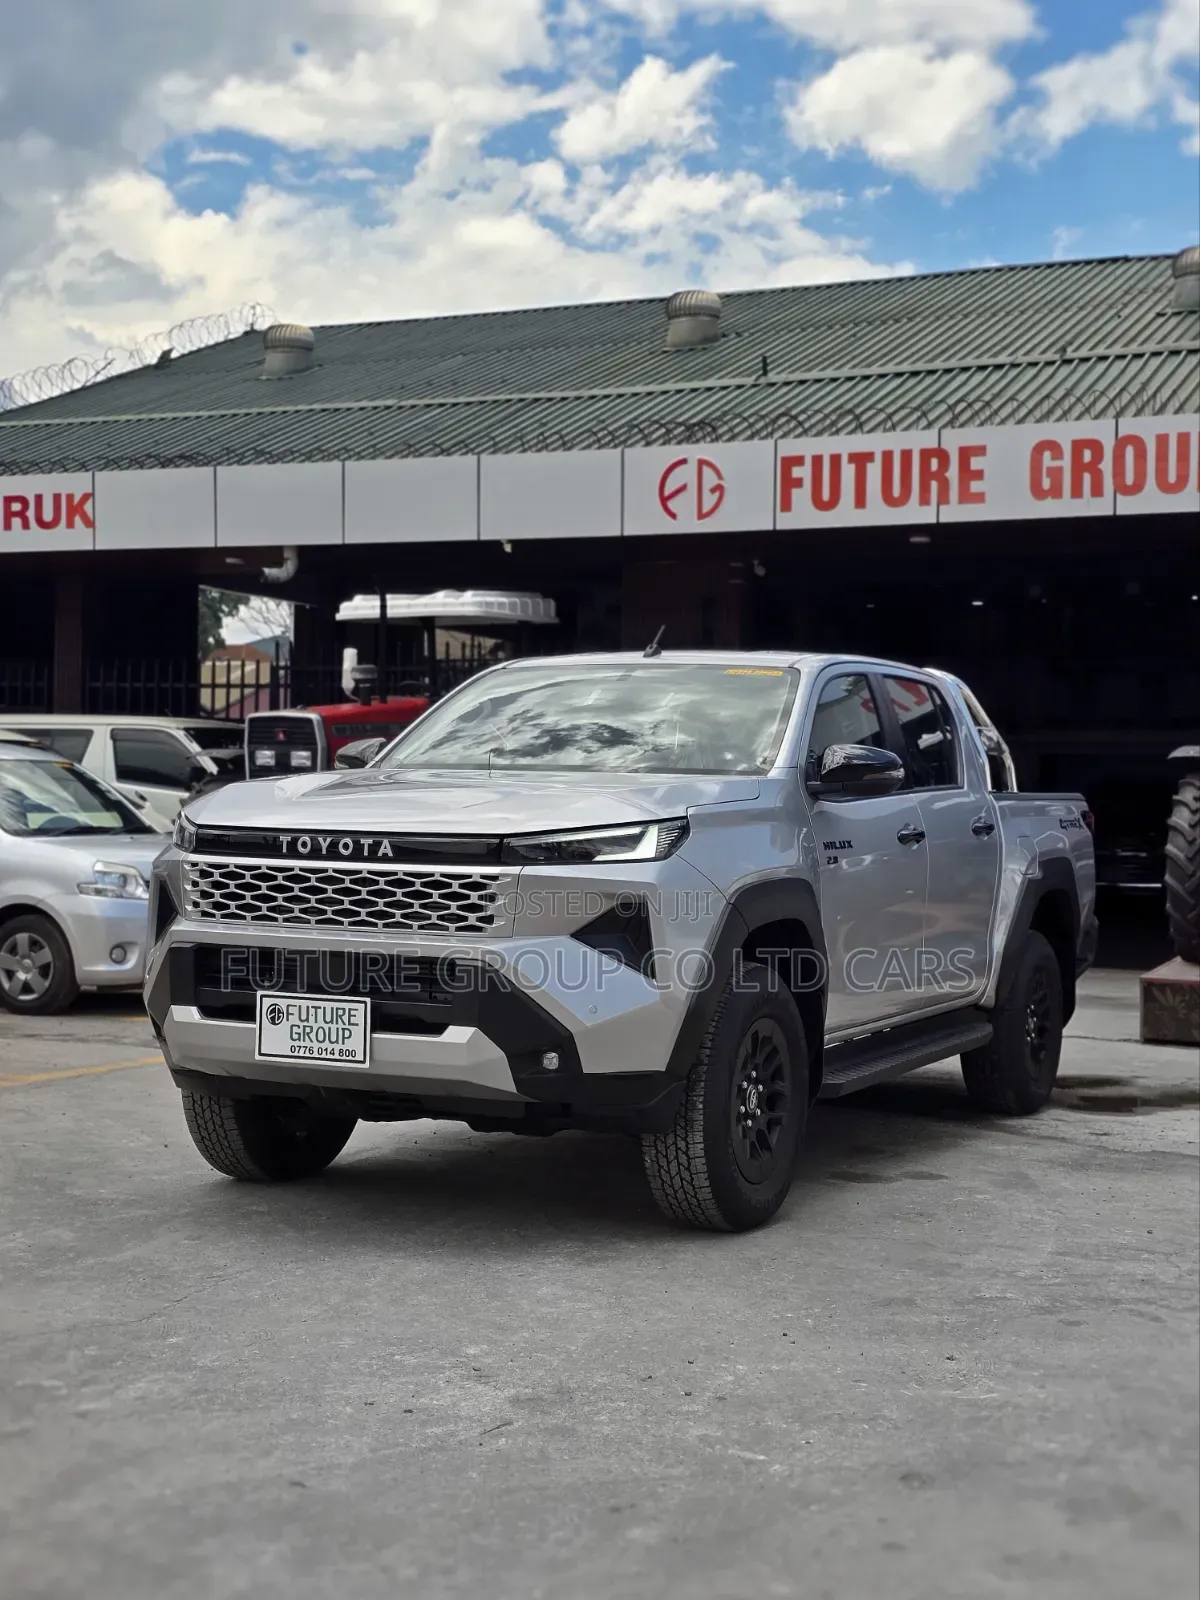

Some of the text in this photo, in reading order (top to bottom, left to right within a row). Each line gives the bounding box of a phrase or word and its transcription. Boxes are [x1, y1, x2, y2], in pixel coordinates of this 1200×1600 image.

[780, 431, 1200, 513] FUTURE GROU
[3, 492, 95, 531] RUK
[280, 836, 393, 857] TOYOTA
[822, 840, 854, 851] HILUX
[286, 1004, 359, 1027] FUTURE
[289, 1024, 353, 1046] GROUP
[290, 1045, 357, 1058] 0776 014 800
